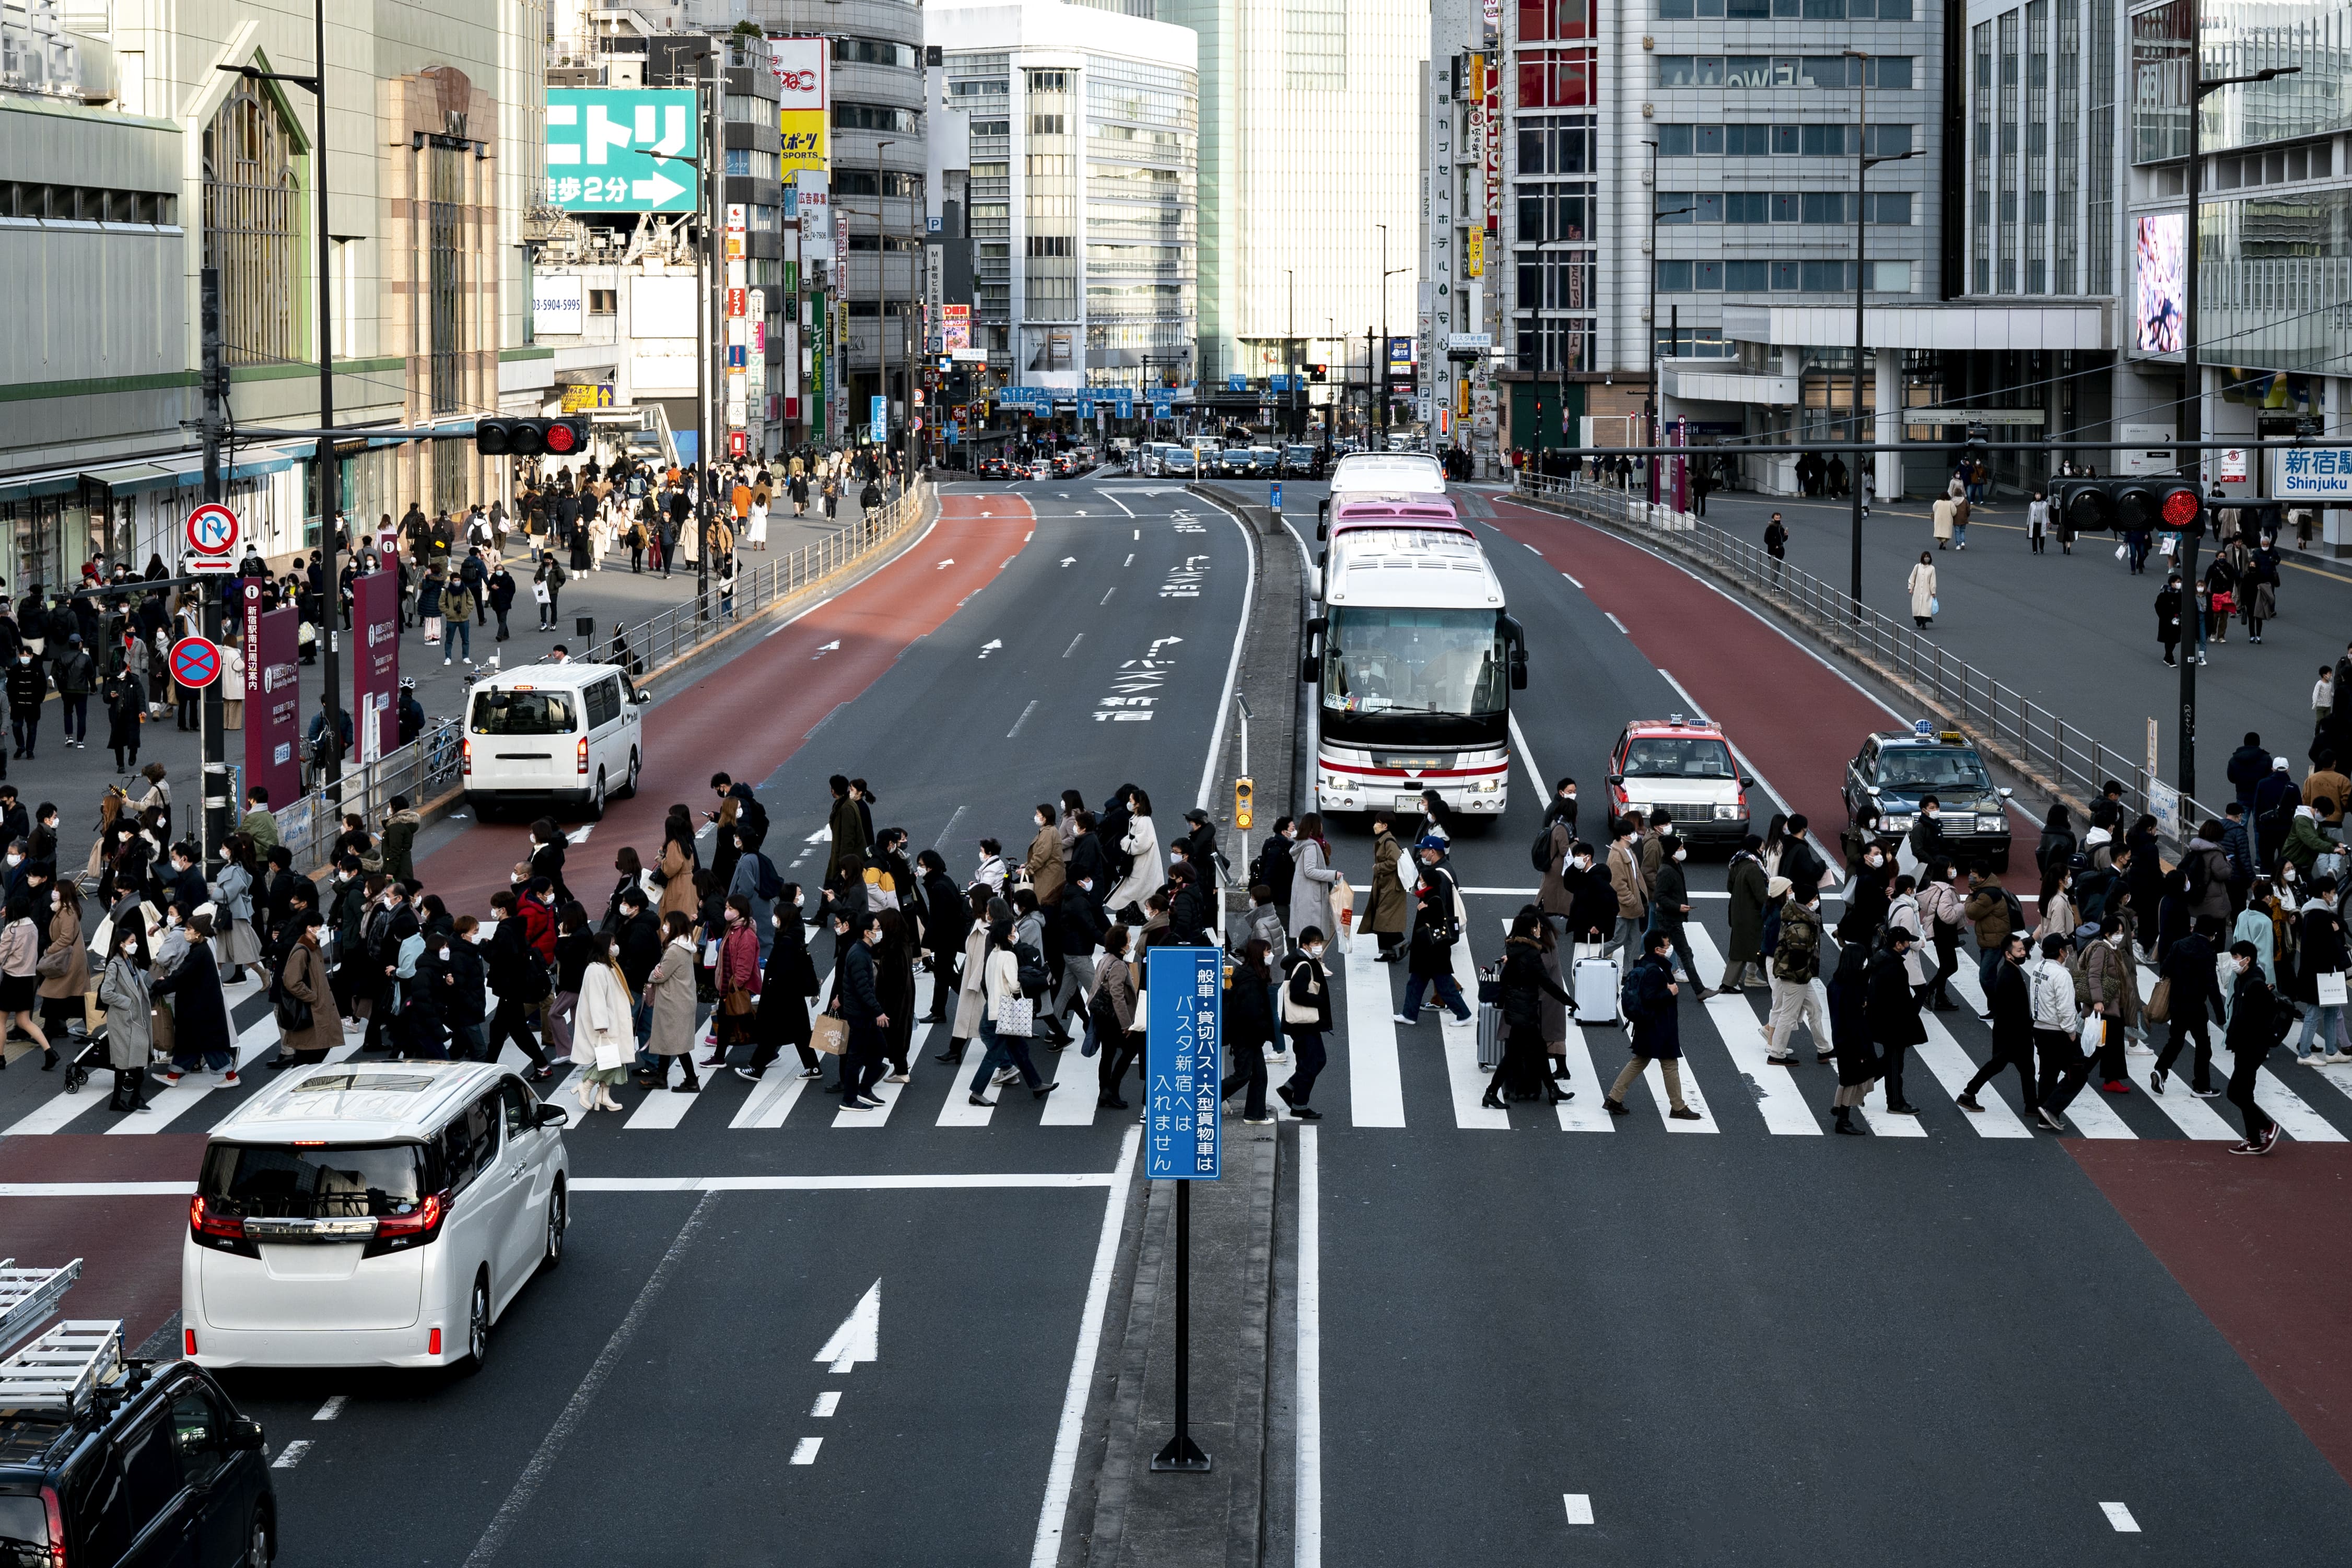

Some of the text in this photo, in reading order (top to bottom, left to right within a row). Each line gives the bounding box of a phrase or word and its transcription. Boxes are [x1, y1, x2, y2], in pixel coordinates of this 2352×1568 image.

[544, 105, 686, 166] ニトリ
[546, 176, 629, 202] 徒歩2分
[799, 192, 827, 205] 広告募集
[1438, 71, 1449, 271] 豪華カプセルホテル
[931, 219, 939, 229] P
[532, 299, 581, 312] 03-5904-5995
[813, 324, 823, 391] レイク ALSA
[1421, 389, 1429, 397] P
[232, 474, 280, 544] PECIAL
[2287, 476, 2348, 492] Shinjuku
[1157, 567, 1211, 597] バスタ新宿
[248, 605, 258, 691] 新宿駅南口周辺案内
[1092, 660, 1175, 721] バスタ新宿
[1175, 995, 1193, 1131] バスタ新宿へは
[1197, 959, 1215, 1171] 一般車・貸切バス・大型貨物車は
[1153, 1074, 1172, 1171] 入れません
